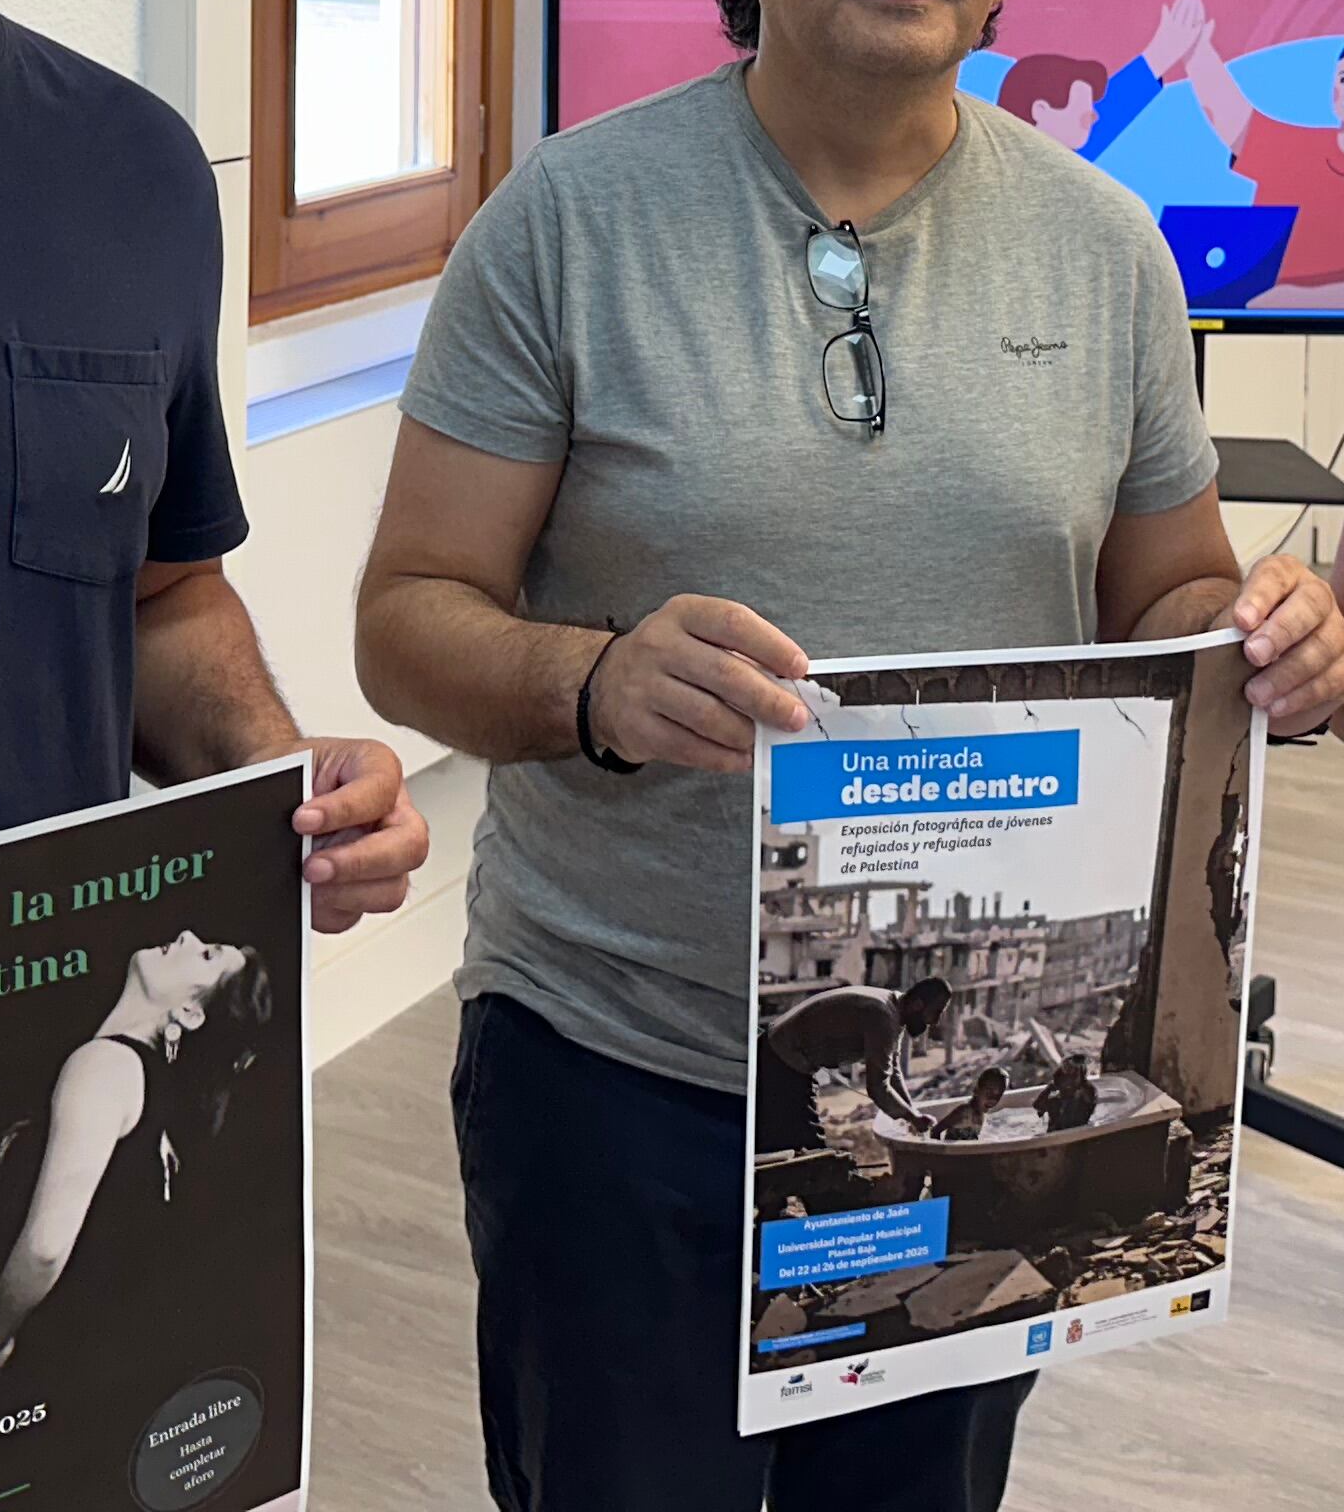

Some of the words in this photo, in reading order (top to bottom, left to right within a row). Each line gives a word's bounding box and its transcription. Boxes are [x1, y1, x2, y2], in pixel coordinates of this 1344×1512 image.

[843, 752, 889, 772] Una
[898, 746, 983, 770] mirada
[841, 774, 940, 805] desde
[946, 773, 1059, 800] dentro
[841, 820, 909, 837] Exposición
[911, 817, 984, 835] fotográfica
[987, 816, 1003, 829] de
[1004, 815, 1053, 831] jóvenes
[840, 840, 909, 857] refugiados
[911, 841, 920, 854] y
[923, 836, 992, 853] refugiadas
[840, 862, 856, 874] de
[860, 858, 919, 873] Palestina
[10, 891, 54, 926] la
[72, 850, 214, 910] mujer
[779, 1266, 795, 1279] Del
[148, 1412, 206, 1448] Entrada
[208, 1396, 241, 1419] libre
[179, 1435, 212, 1457] Hasta
[169, 1446, 226, 1480] completar
[184, 1469, 215, 1491] aforo
